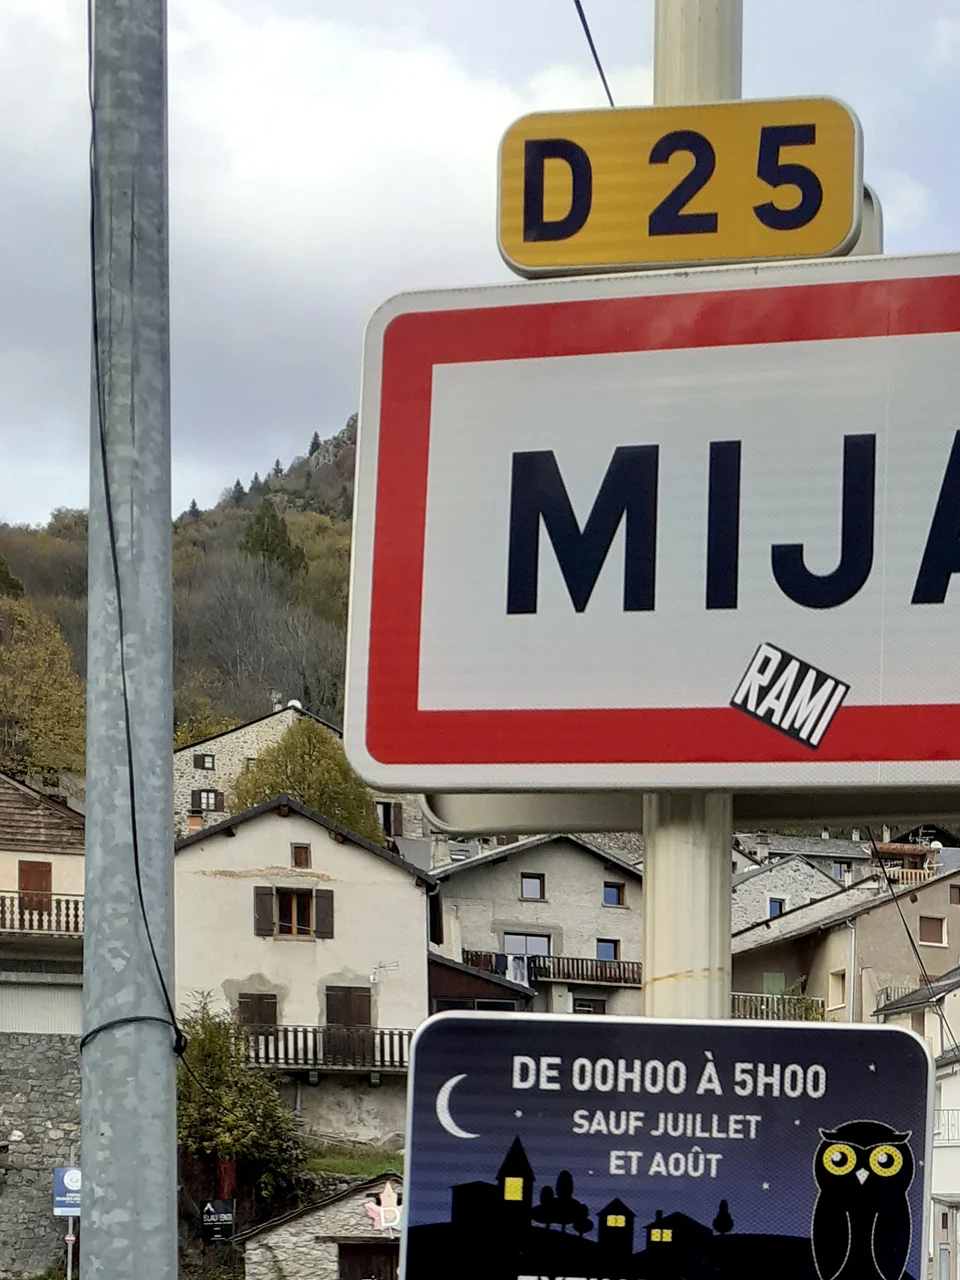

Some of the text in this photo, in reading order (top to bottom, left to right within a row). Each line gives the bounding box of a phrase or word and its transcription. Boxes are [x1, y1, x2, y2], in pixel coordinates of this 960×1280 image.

[523, 123, 823, 243] D 25
[733, 643, 847, 747] RAMI
[512, 1051, 827, 1099] DE 00H00 À 5H00
[572, 1109, 761, 1140] SAUF JUILLET
[609, 1145, 723, 1178] ET AOÛT
[381, 1206, 400, 1227] D
